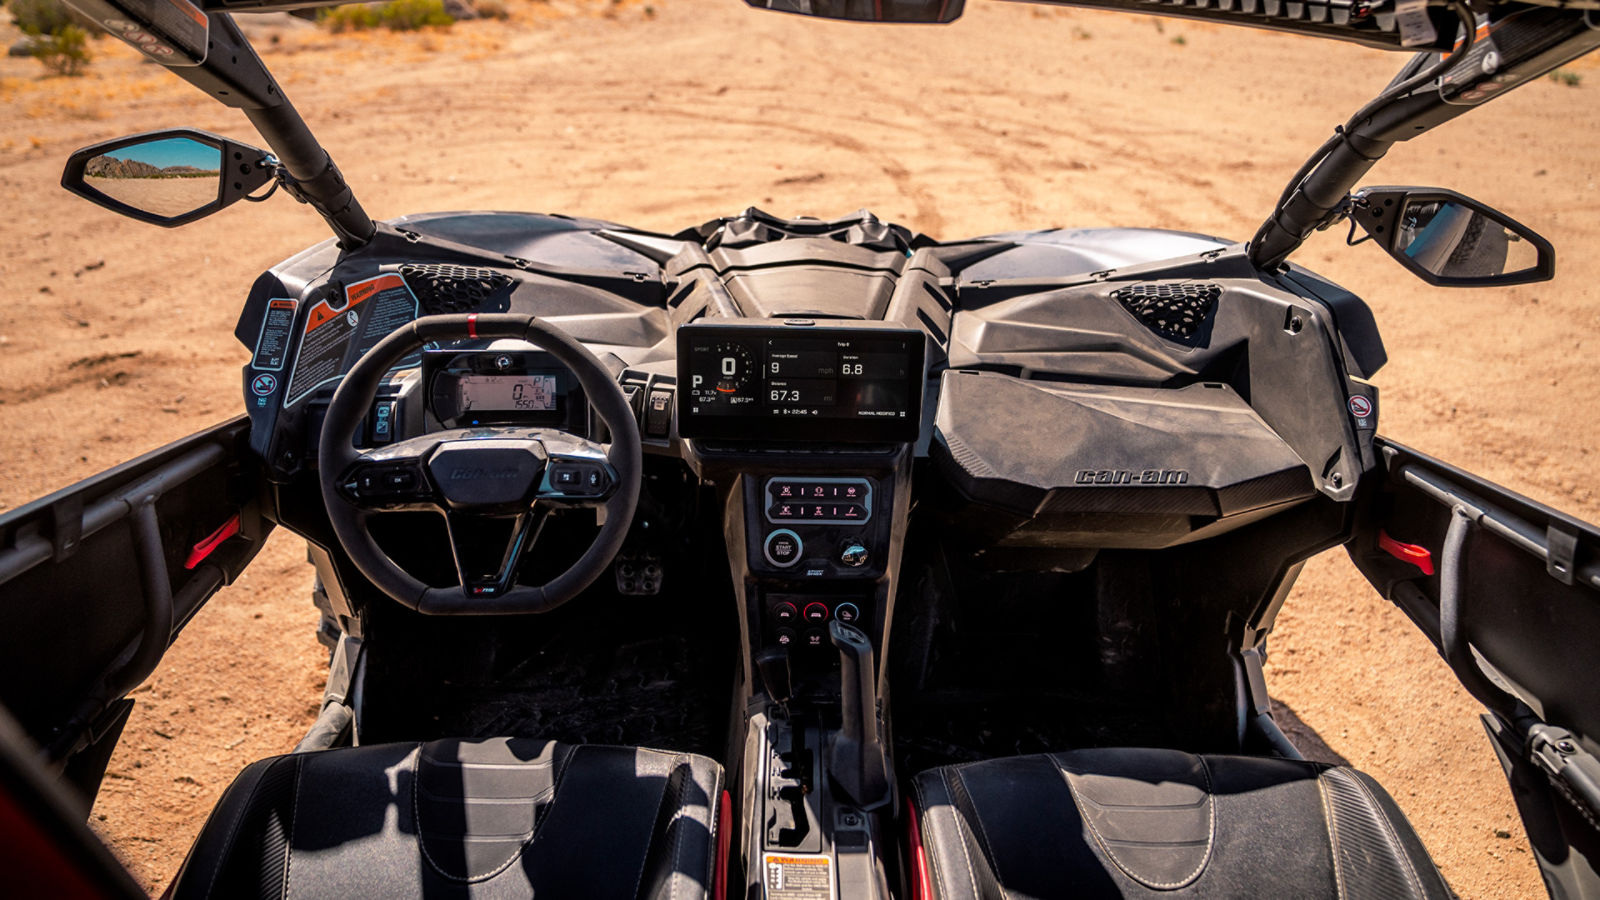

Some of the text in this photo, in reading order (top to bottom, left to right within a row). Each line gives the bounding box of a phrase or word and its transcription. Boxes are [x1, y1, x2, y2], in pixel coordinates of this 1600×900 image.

[351, 284, 375, 301] WARNING
[721, 357, 736, 376] 0
[771, 362, 780, 374] 9
[818, 367, 834, 376] mph
[842, 363, 863, 375] 6.8
[692, 374, 703, 388] P
[512, 383, 524, 401] 0
[770, 390, 800, 402] 67.3
